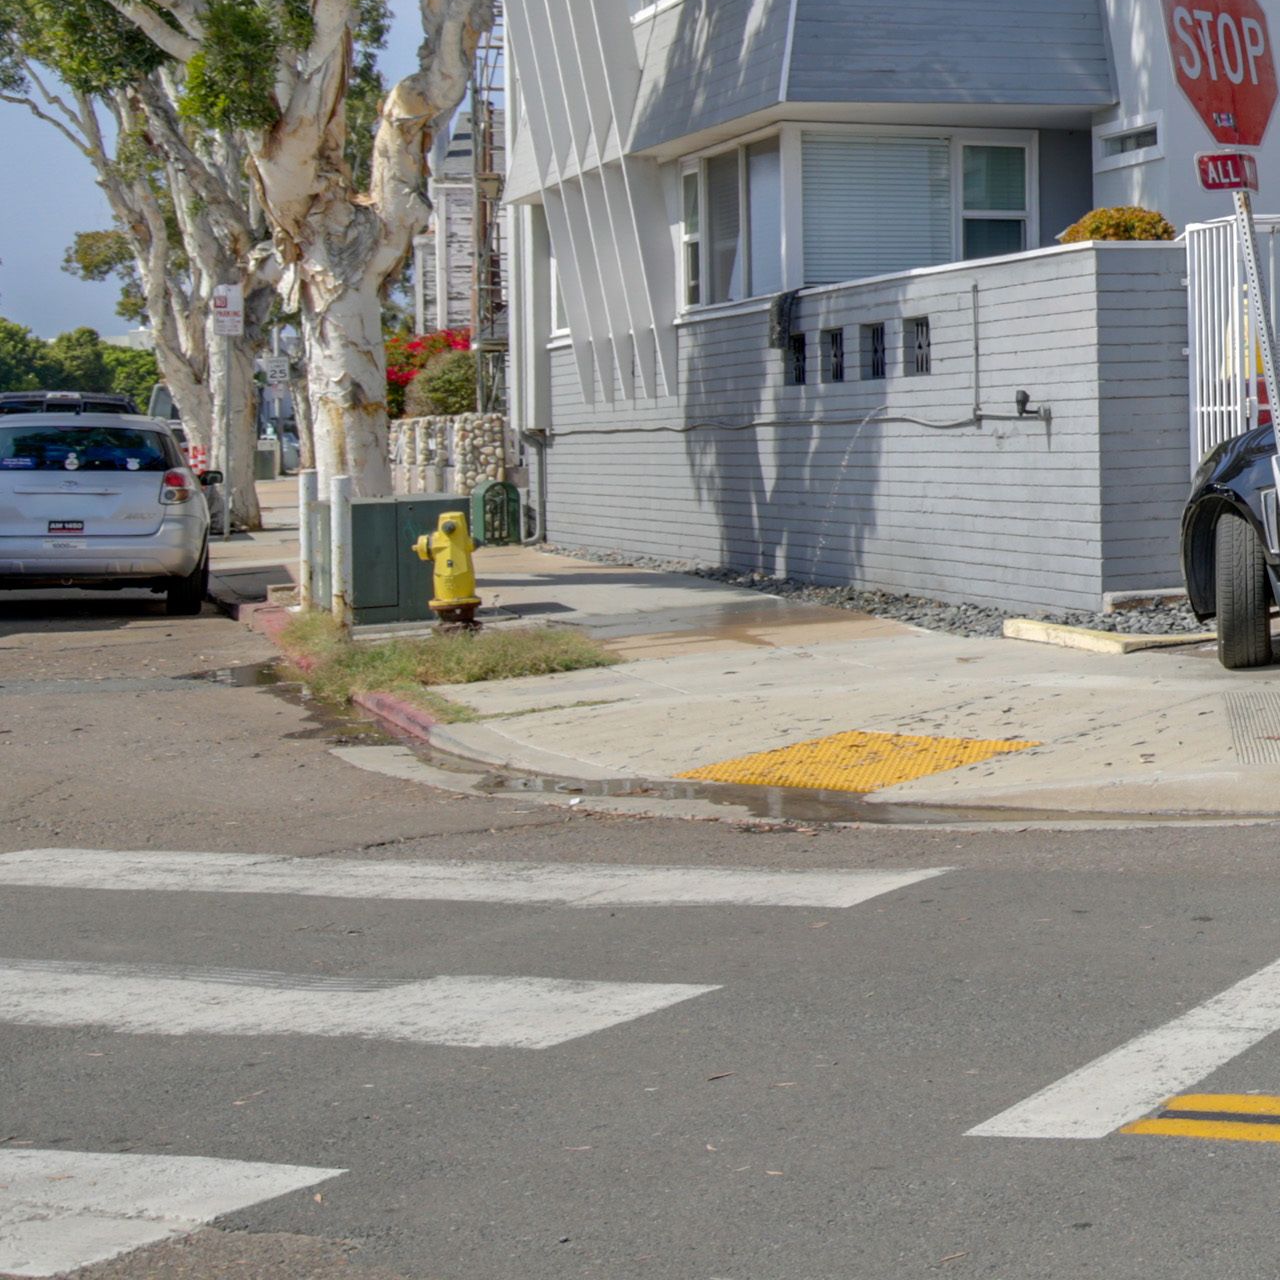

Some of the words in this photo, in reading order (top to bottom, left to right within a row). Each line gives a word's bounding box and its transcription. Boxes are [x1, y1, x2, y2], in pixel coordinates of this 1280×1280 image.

[1173, 6, 1265, 85] STOP
[1208, 160, 1240, 184] ALL
[270, 369, 287, 379] 25
